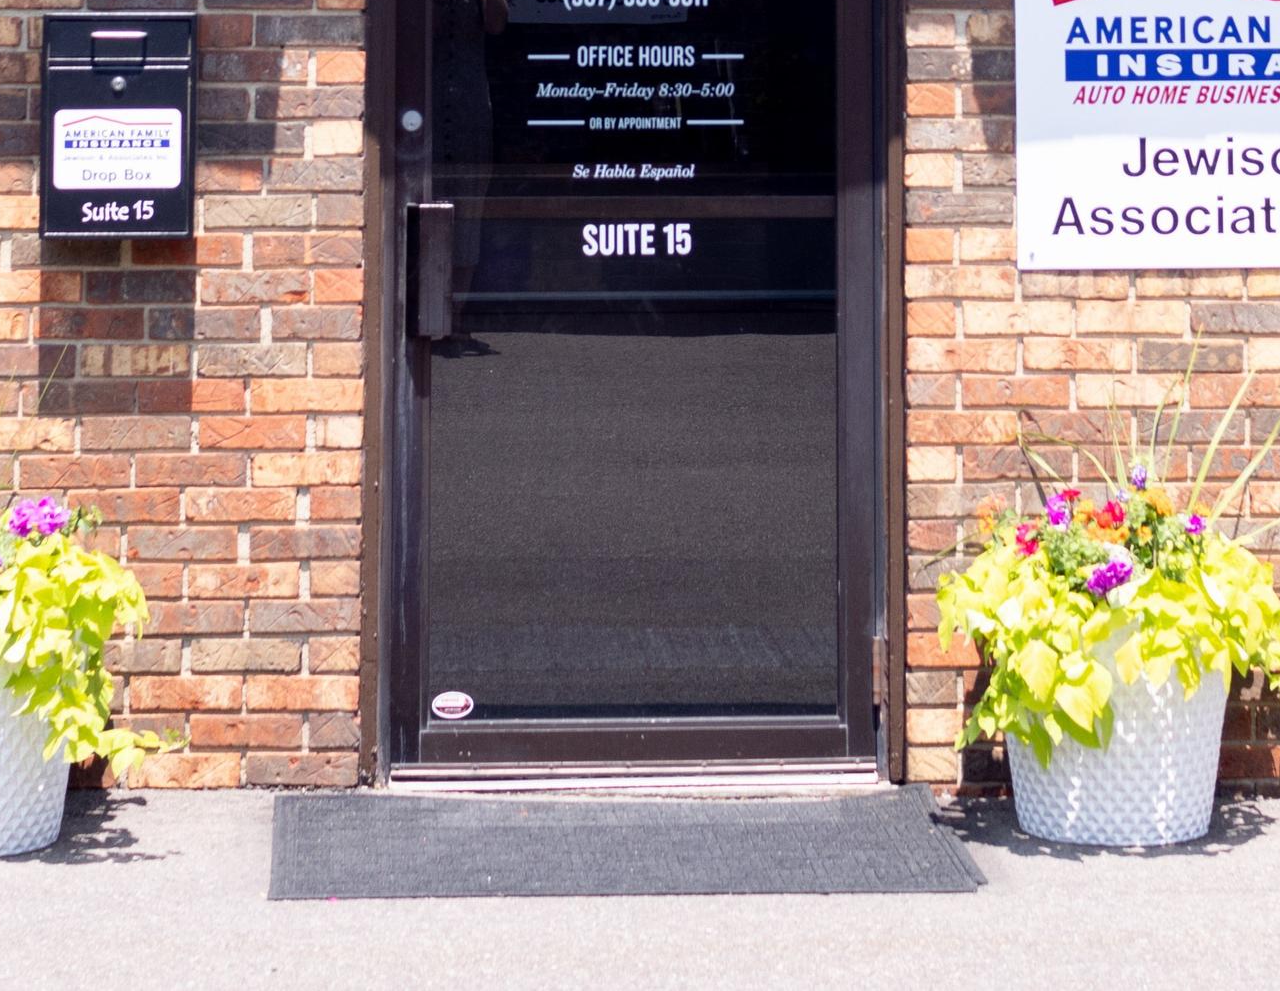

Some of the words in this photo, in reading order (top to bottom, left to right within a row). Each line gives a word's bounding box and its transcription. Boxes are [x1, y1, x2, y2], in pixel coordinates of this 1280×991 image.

[1067, 16, 1270, 43] AMERICAN
[578, 46, 633, 66] OFFICE
[639, 46, 694, 66] HOURS
[1074, 86, 1125, 104] AUTO
[1132, 86, 1190, 104] HOME
[590, 118, 602, 129] OR
[605, 118, 616, 129] BY
[618, 117, 681, 129] APPOINTMENT
[65, 129, 125, 138] AMERICAN
[130, 129, 171, 137] FAMILY
[72, 140, 163, 148] INSURANCE
[82, 170, 117, 182] Drop
[124, 169, 152, 181] Box
[573, 165, 589, 177] Se
[594, 165, 635, 177] Habla
[640, 164, 694, 180] Español
[82, 202, 129, 222] Suite
[133, 200, 154, 219] 15
[583, 224, 655, 256] SUITE
[663, 224, 691, 254] 15
